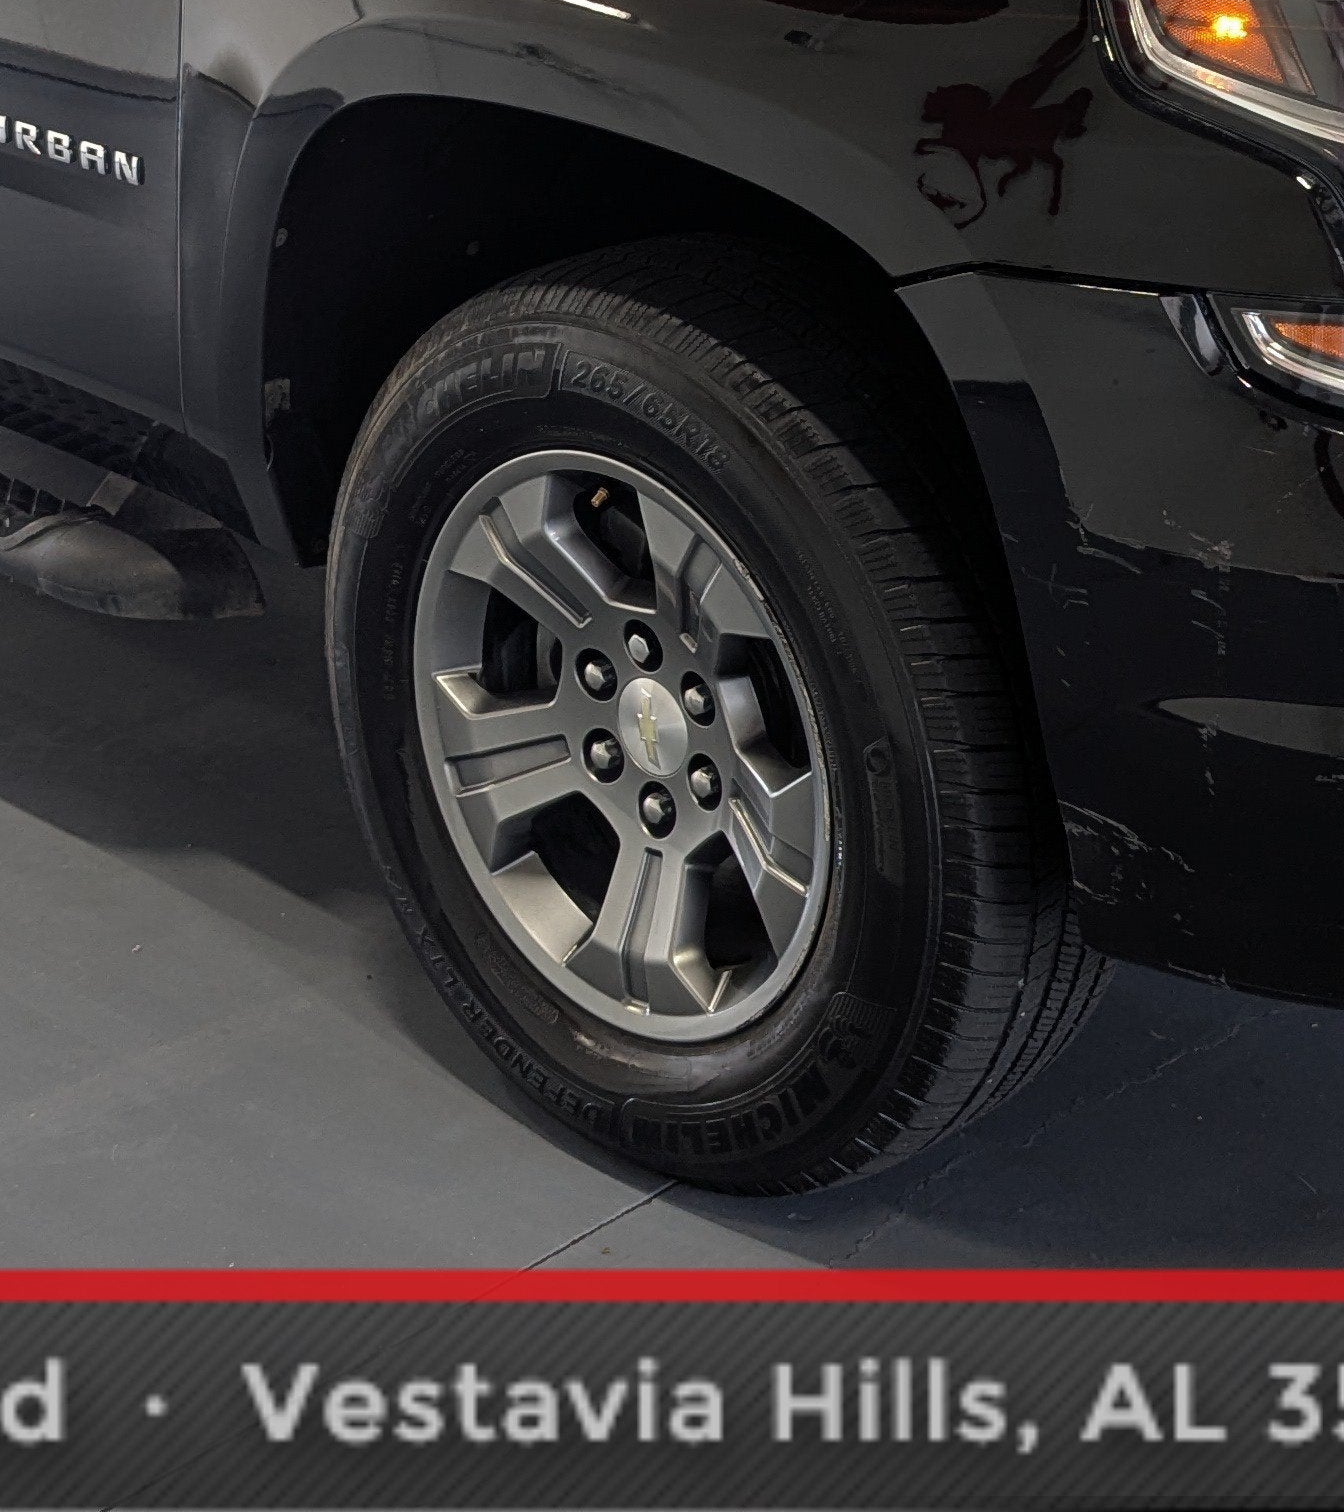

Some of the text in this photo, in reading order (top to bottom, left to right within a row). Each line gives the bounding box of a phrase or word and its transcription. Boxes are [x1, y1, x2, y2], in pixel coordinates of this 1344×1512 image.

[569, 359, 733, 472] 265/65R18
[461, 998, 606, 1127] DEFENDER
[630, 1069, 833, 1156] MICHELIN
